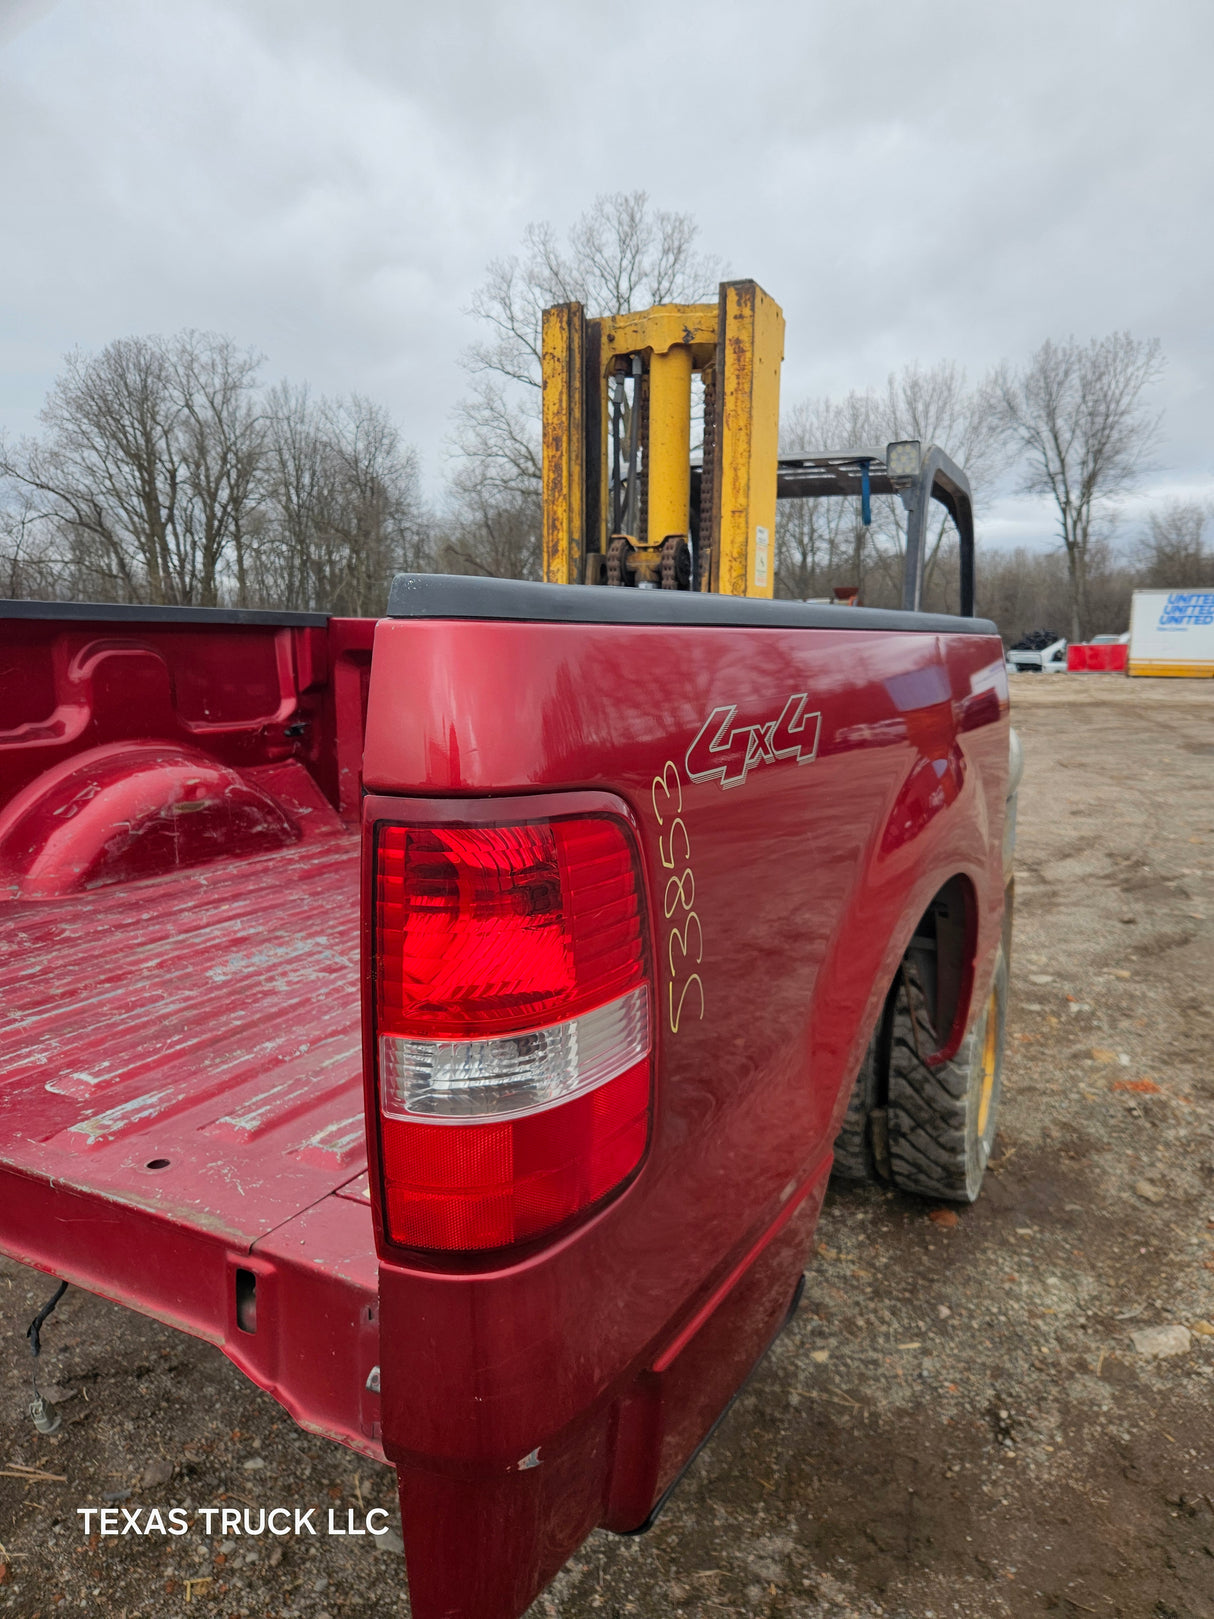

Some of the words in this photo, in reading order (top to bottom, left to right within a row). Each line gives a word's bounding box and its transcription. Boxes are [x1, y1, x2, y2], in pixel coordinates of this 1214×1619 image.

[1159, 615, 1214, 625] UNITED
[685, 692, 821, 791] 4x4
[652, 760, 704, 1034] 53853
